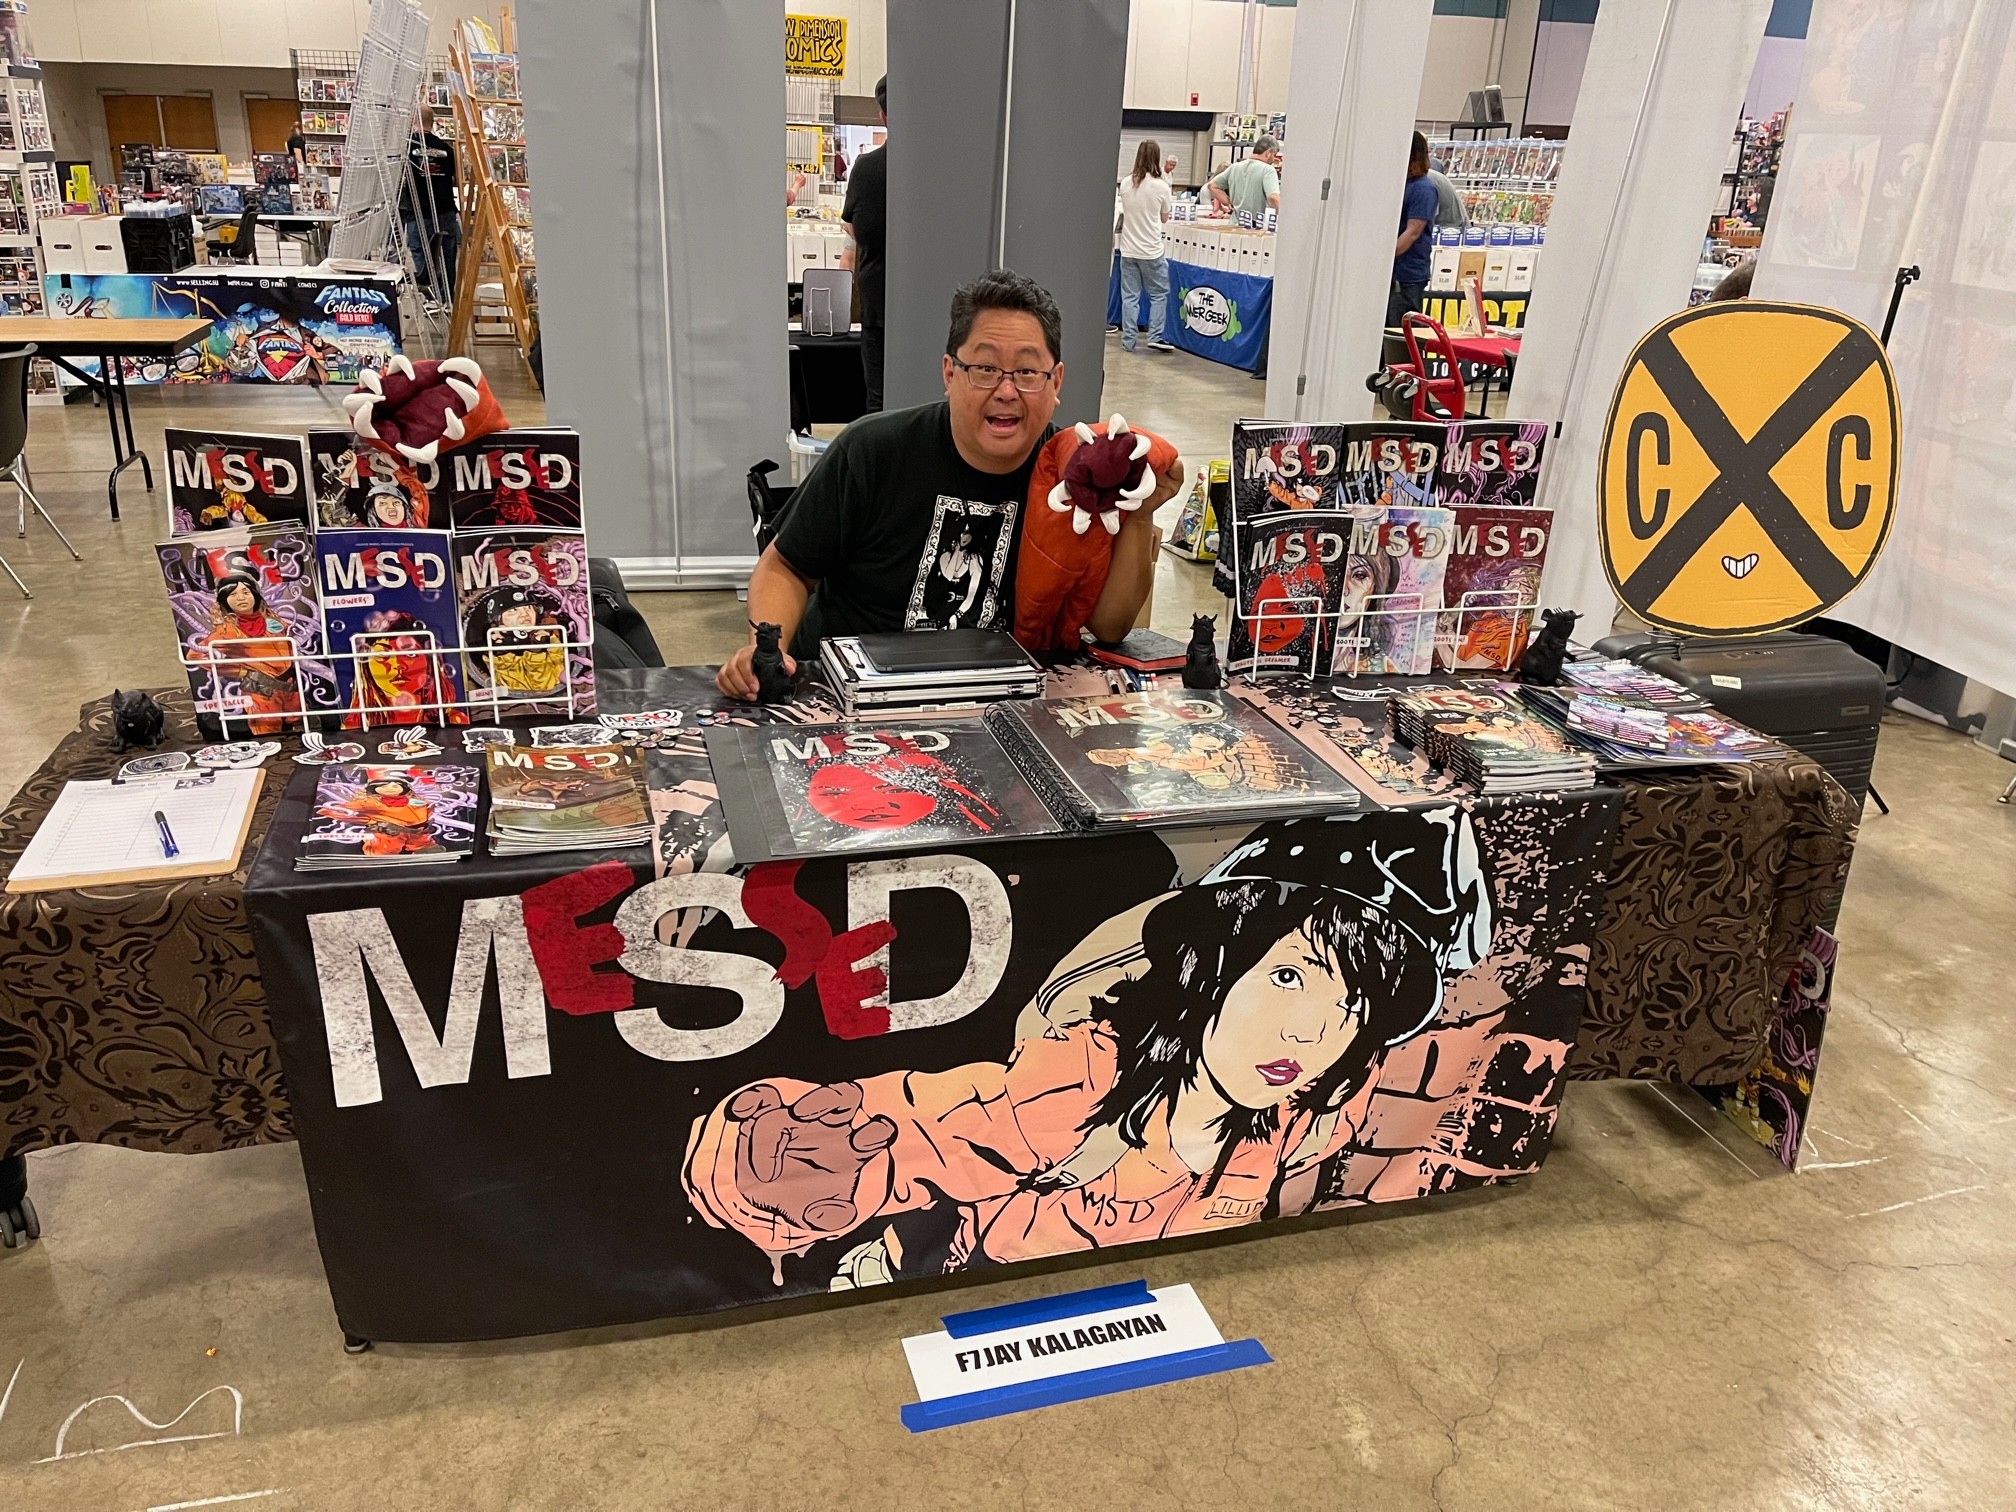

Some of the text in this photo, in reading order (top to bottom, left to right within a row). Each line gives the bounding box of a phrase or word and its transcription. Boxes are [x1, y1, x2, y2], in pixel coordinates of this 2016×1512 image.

[799, 18, 842, 40] DIMENSION
[786, 37, 843, 67] OMICS
[313, 285, 392, 306] FANTAST
[1199, 292, 1214, 306] THE
[323, 300, 380, 314] Collection
[1483, 649, 1501, 661] MSD
[203, 698, 246, 710] SPETACLE
[1026, 1313, 1168, 1358] KALAGAYAN
